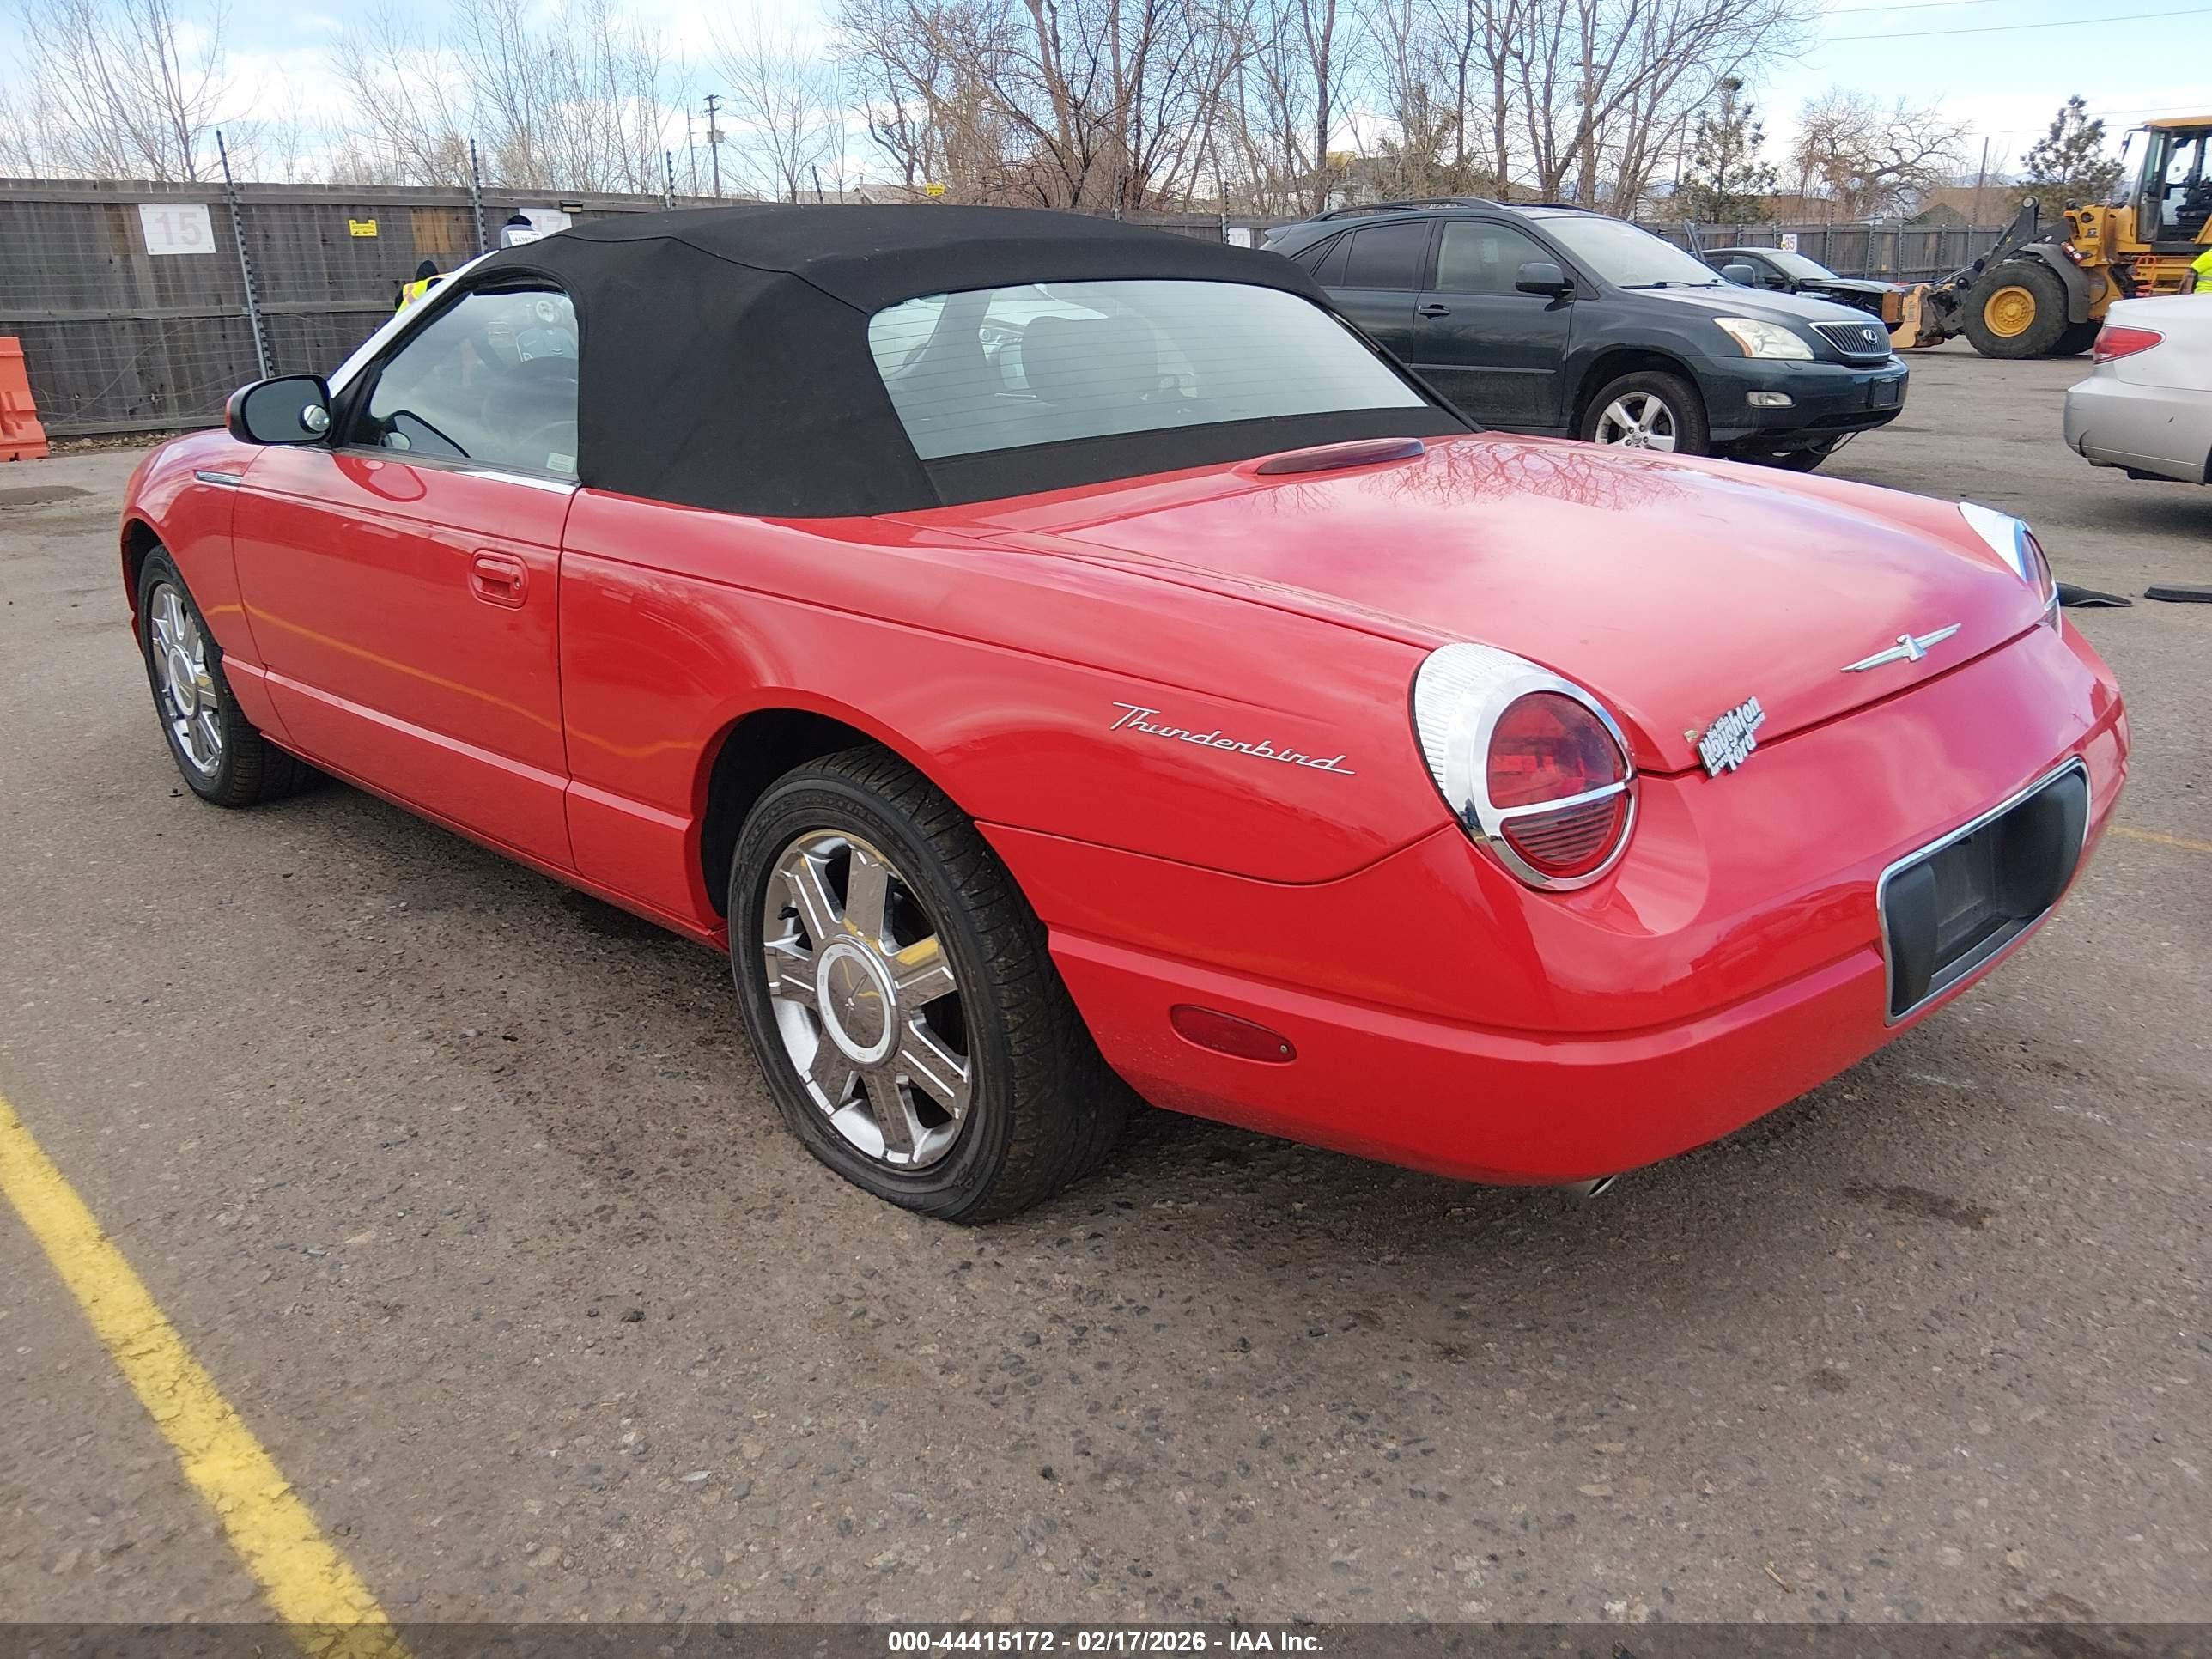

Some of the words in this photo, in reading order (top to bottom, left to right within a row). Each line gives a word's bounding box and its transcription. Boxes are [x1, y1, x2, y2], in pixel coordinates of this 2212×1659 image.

[155, 211, 201, 246] 15
[1109, 701, 1357, 775] Thunderbird
[1724, 727, 1758, 771] Ford
